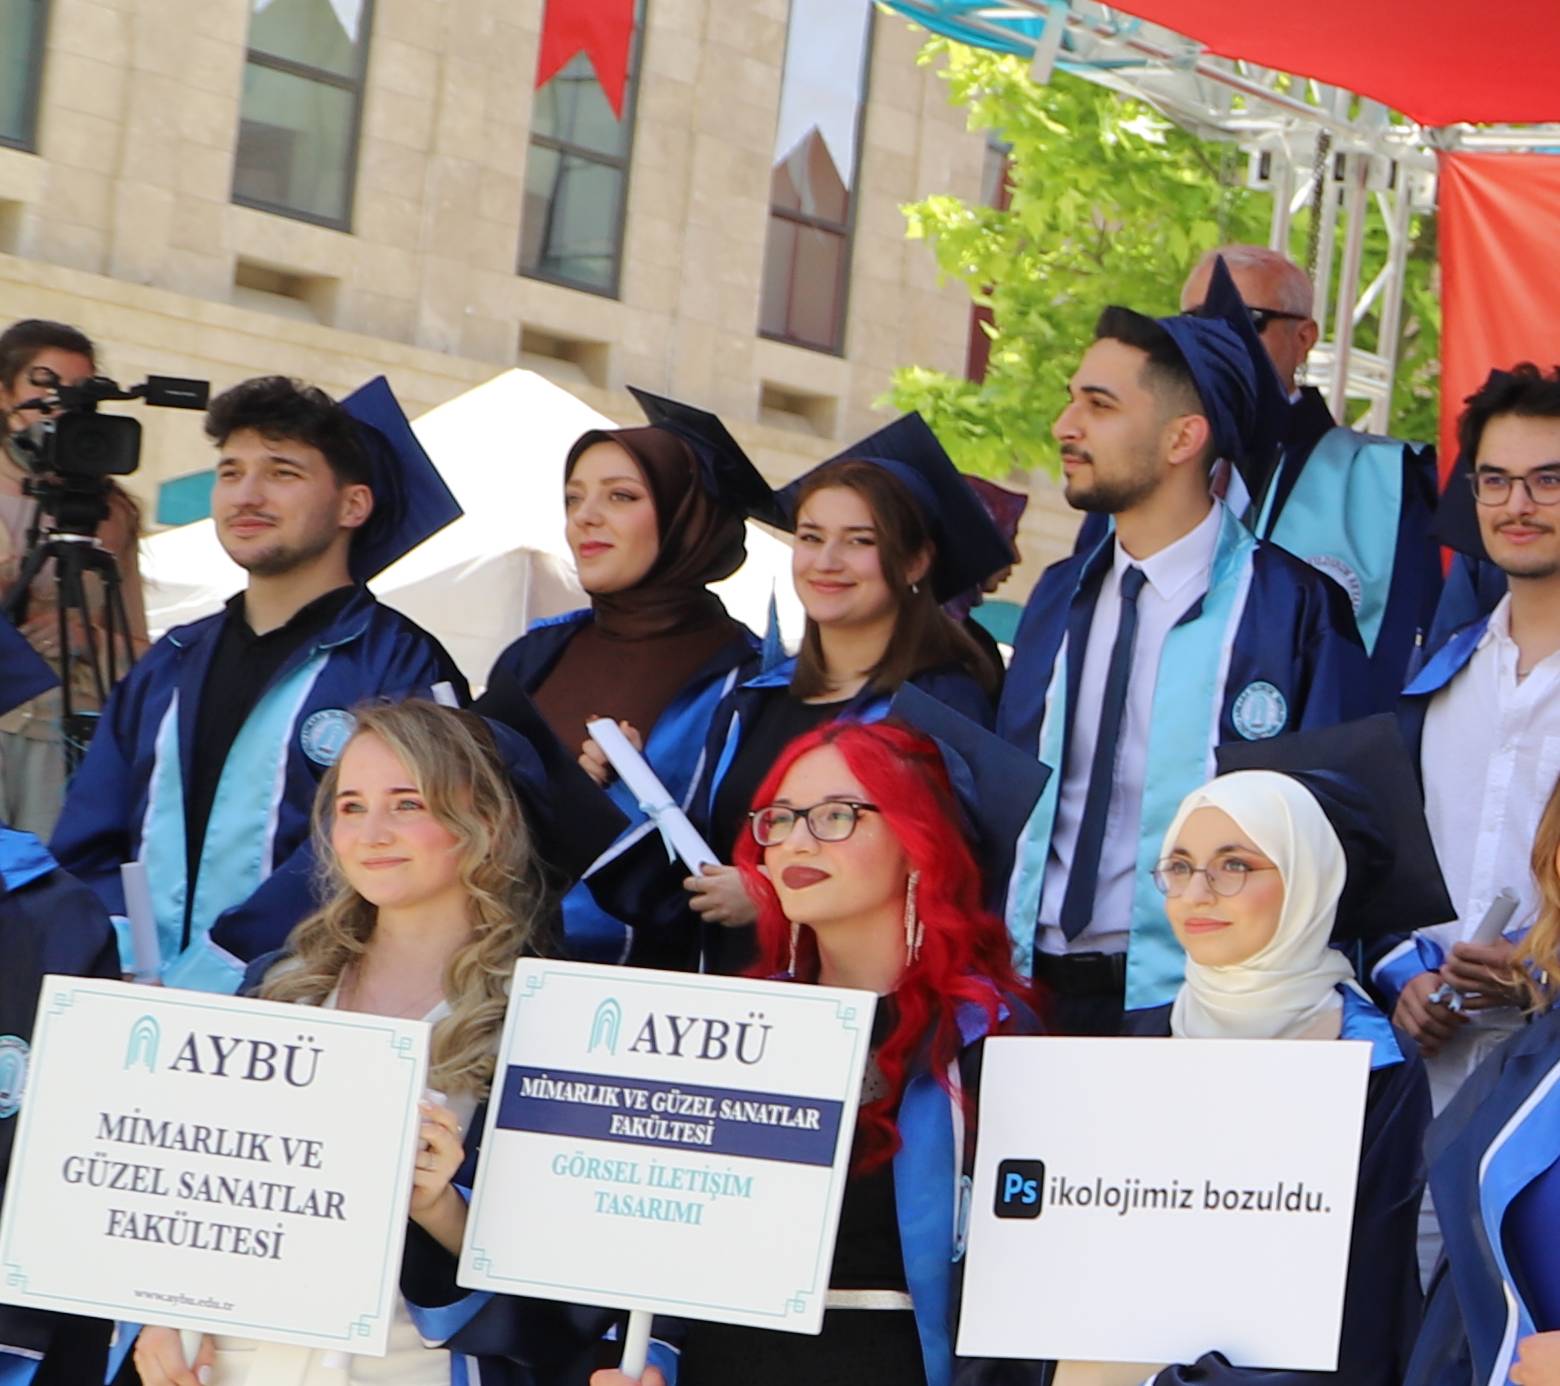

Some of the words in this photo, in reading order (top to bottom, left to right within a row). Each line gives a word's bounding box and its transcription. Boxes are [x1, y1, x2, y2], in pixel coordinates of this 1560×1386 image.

[168, 1031, 324, 1087] AYBÜ
[628, 1012, 773, 1065] AYBÜ
[519, 1074, 620, 1108] MİMARLIK
[623, 1088, 648, 1111] VE
[651, 1089, 717, 1119] GÜZEL
[719, 1099, 821, 1130] SANATLAR
[96, 1108, 271, 1163] MİMARLIK
[280, 1135, 324, 1170] VE
[609, 1114, 715, 1146] FAKÜLTESİ
[62, 1151, 168, 1197] GÜZEL
[176, 1170, 347, 1221] SANATLAR
[551, 1150, 642, 1186] GÖRSEL
[647, 1158, 754, 1201] İLETİŞİM
[1203, 1180, 1332, 1213] bozuldu.
[594, 1190, 704, 1225] TASARIMI
[105, 1208, 285, 1260] FAKÜLTESİ
